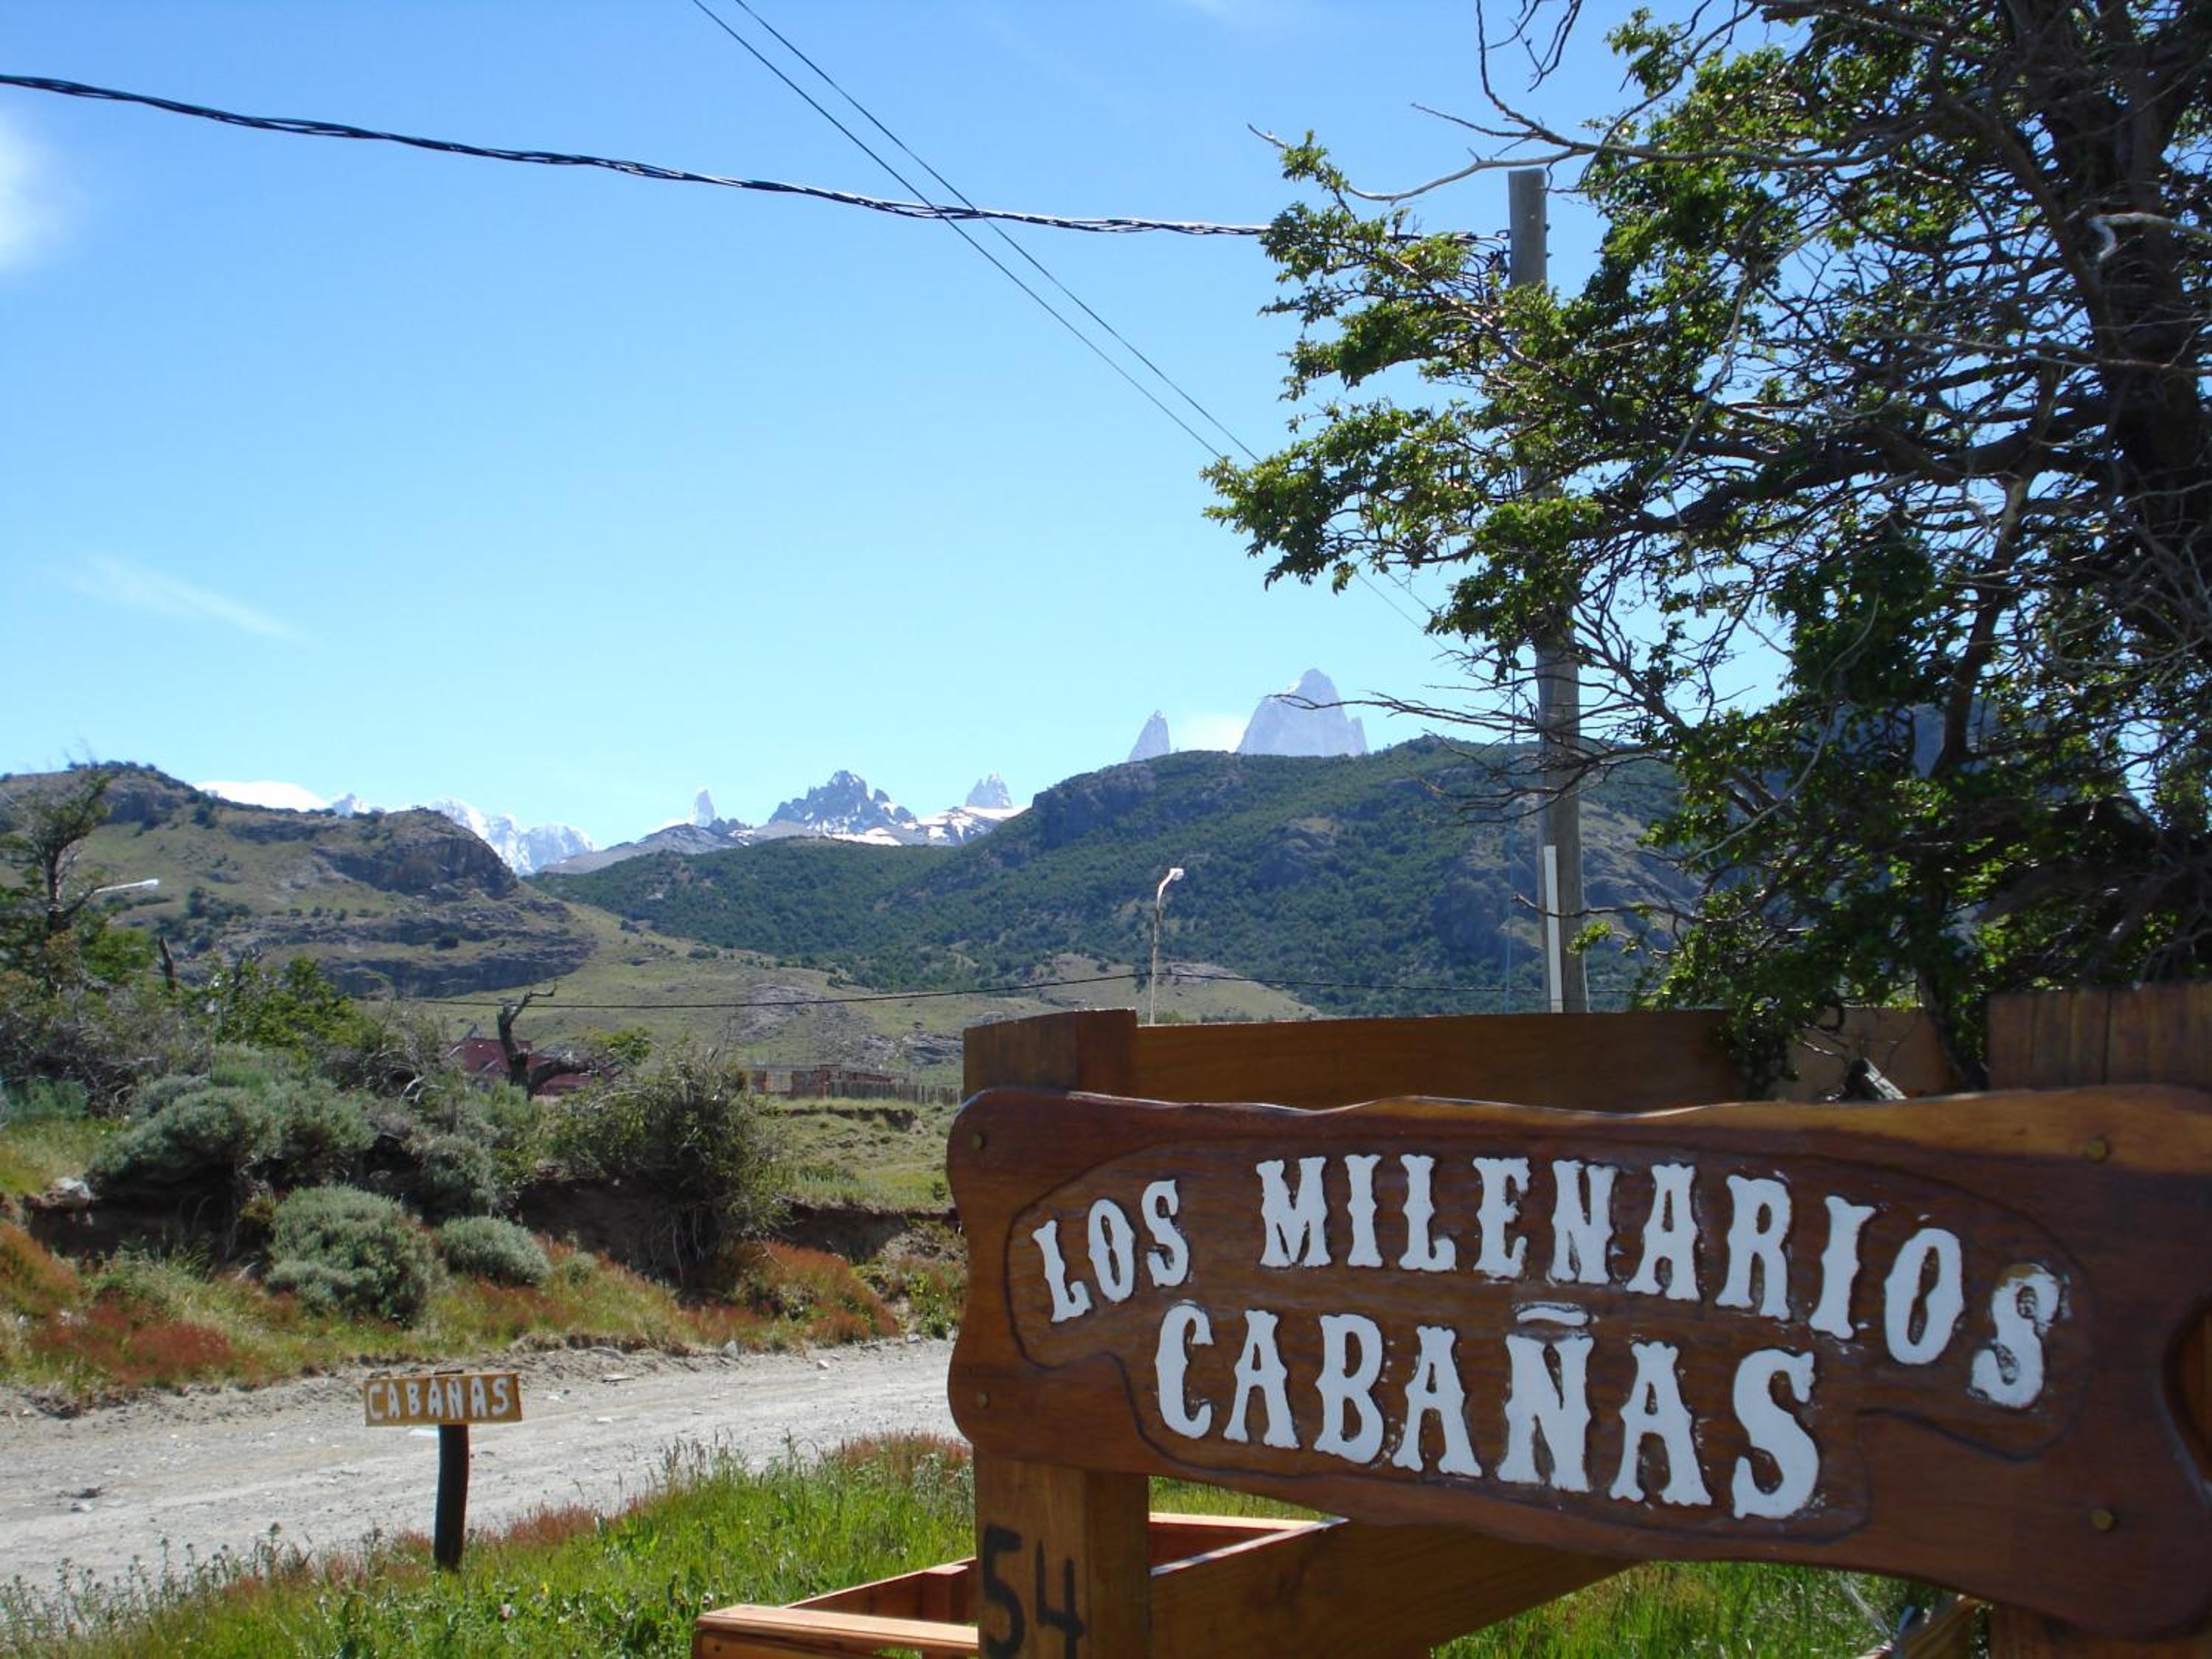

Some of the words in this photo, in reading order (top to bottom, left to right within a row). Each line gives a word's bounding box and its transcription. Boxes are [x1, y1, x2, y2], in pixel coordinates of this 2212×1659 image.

[1034, 1180, 1189, 1322] LOS
[1256, 1154, 2062, 1408] MILENARIOS
[1155, 1300, 1819, 1519] CABAÑAS
[983, 1524, 1085, 1658] 54
